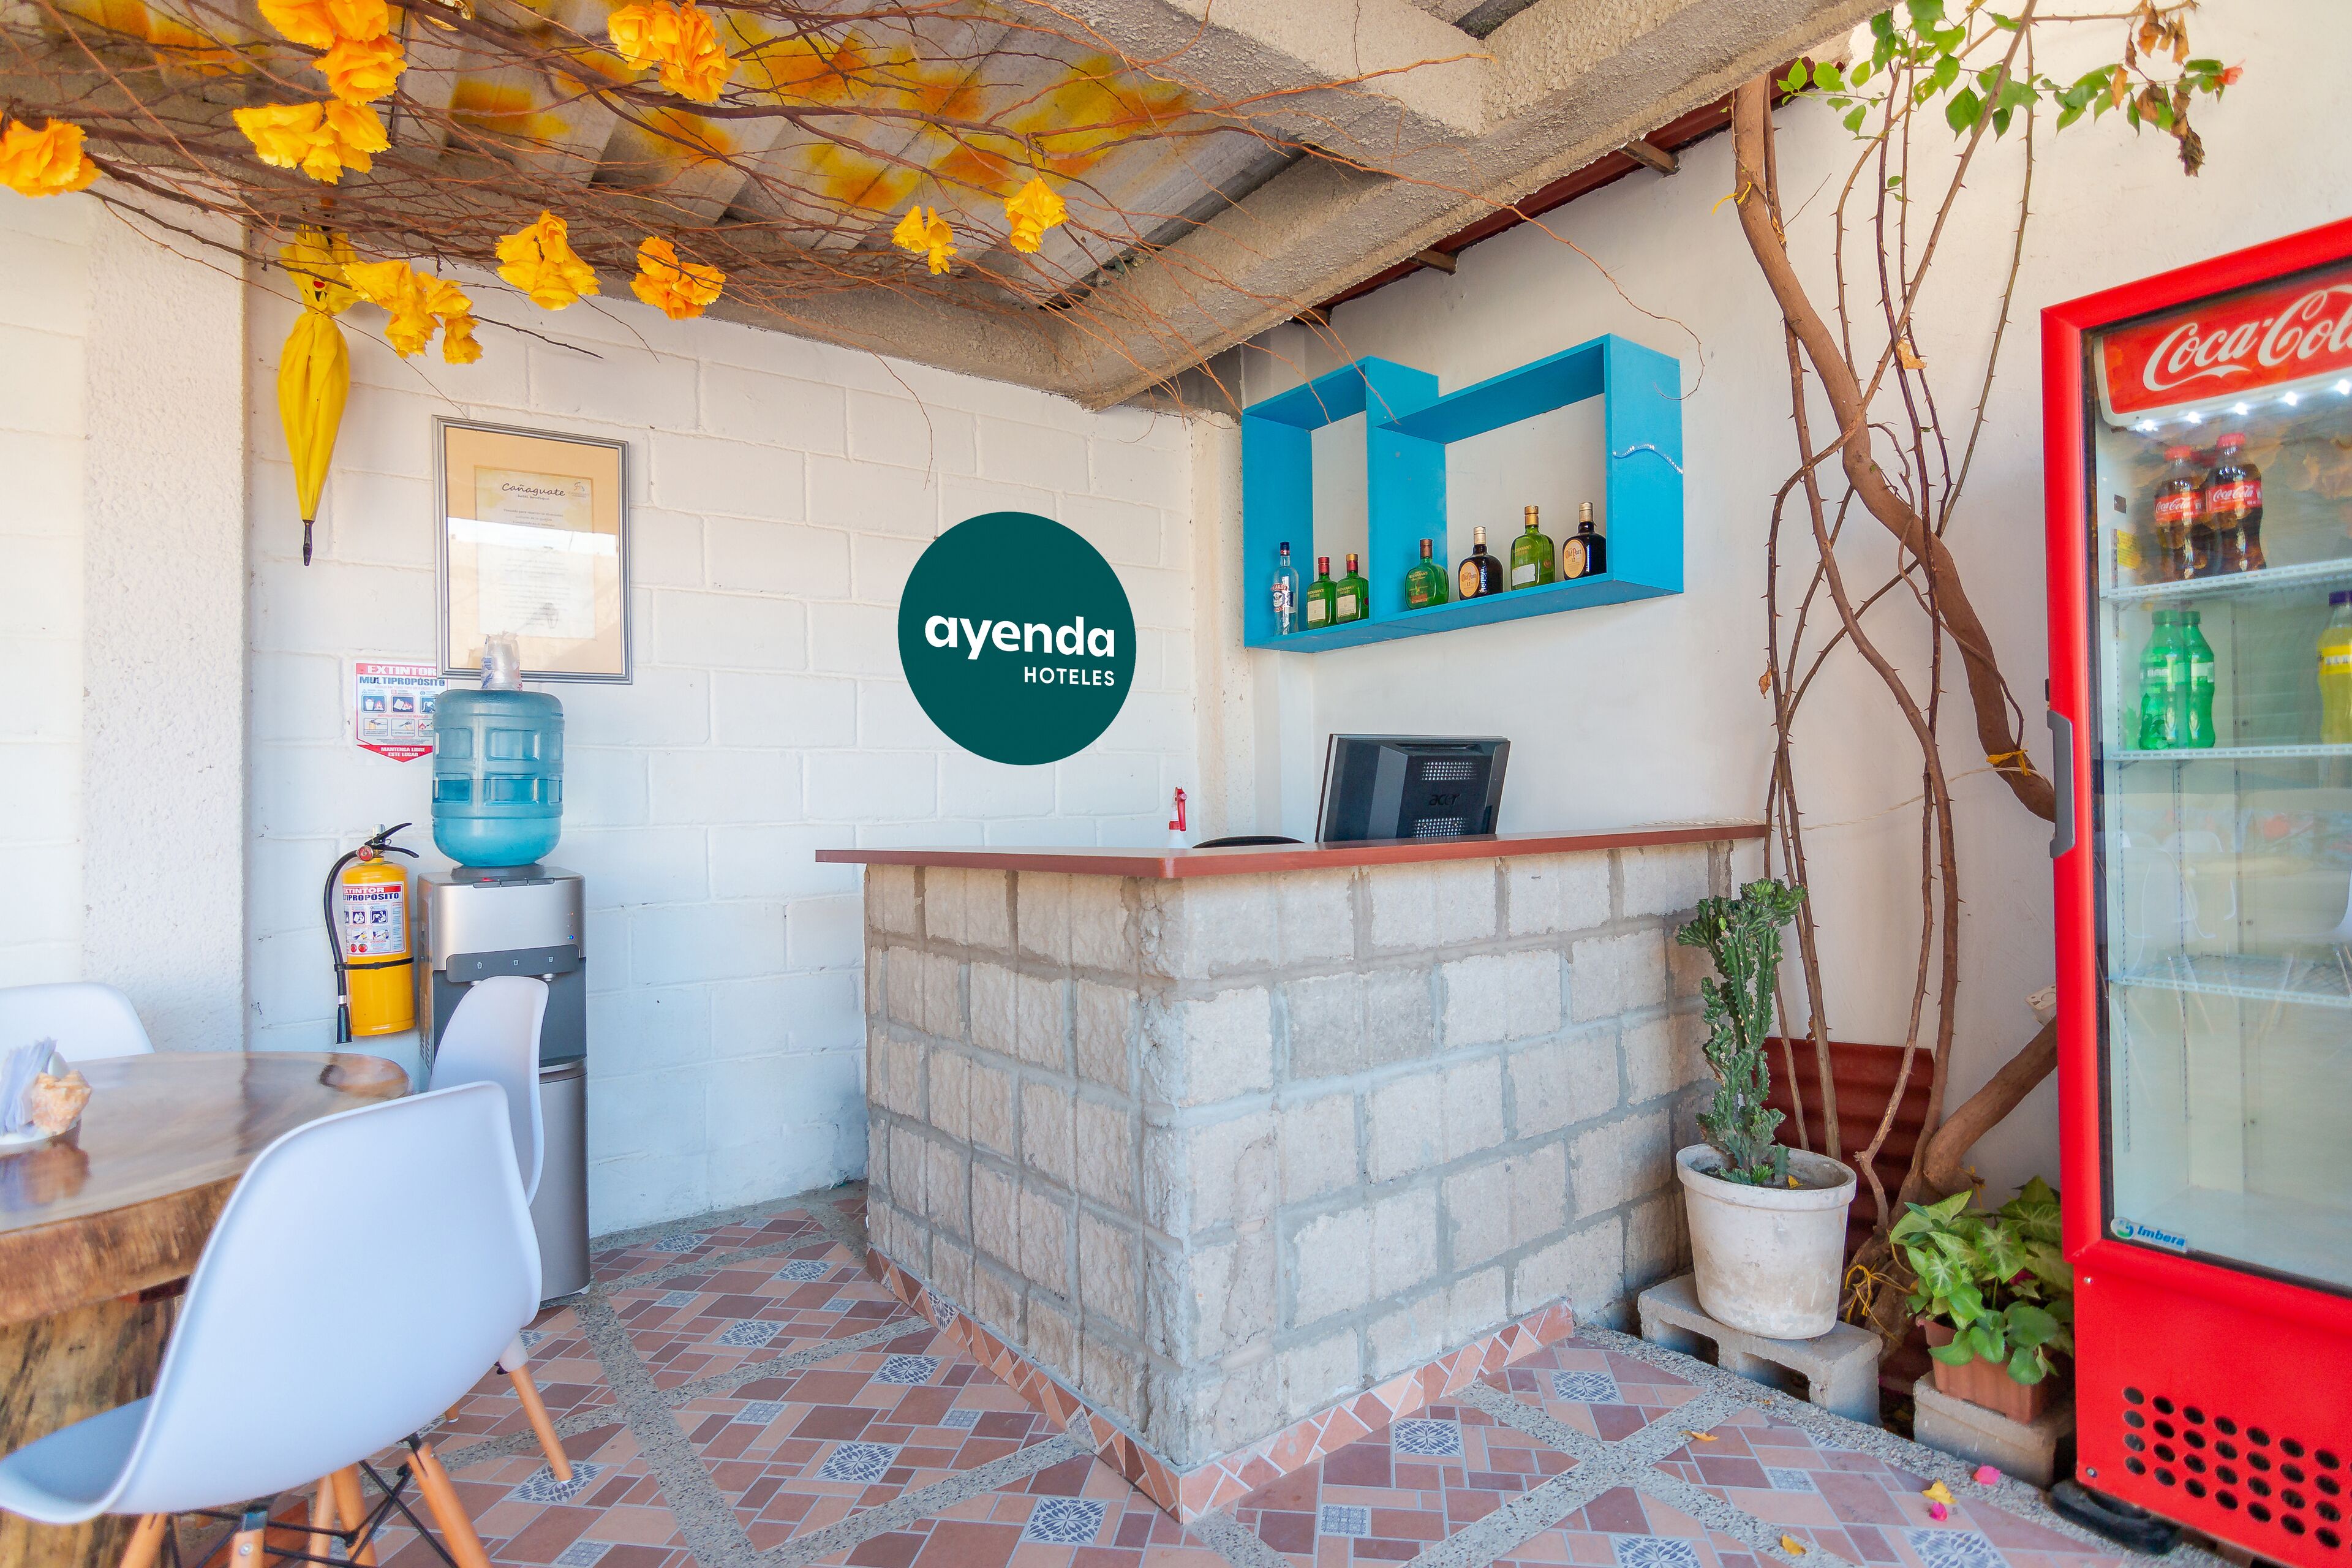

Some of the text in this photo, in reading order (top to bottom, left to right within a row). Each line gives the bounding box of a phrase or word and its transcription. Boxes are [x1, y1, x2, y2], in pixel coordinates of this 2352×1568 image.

[2143, 284, 2352, 391] Coca-Col
[502, 483, 565, 497] Cañaguate
[2213, 485, 2254, 502] Coca-Cola
[2155, 497, 2192, 512] Coca-Cola
[925, 615, 1115, 660] ayenda
[368, 665, 437, 676] EXTINTOR
[1024, 666, 1115, 687] HOTELES
[360, 676, 445, 687] MULTIPROPÓSITO
